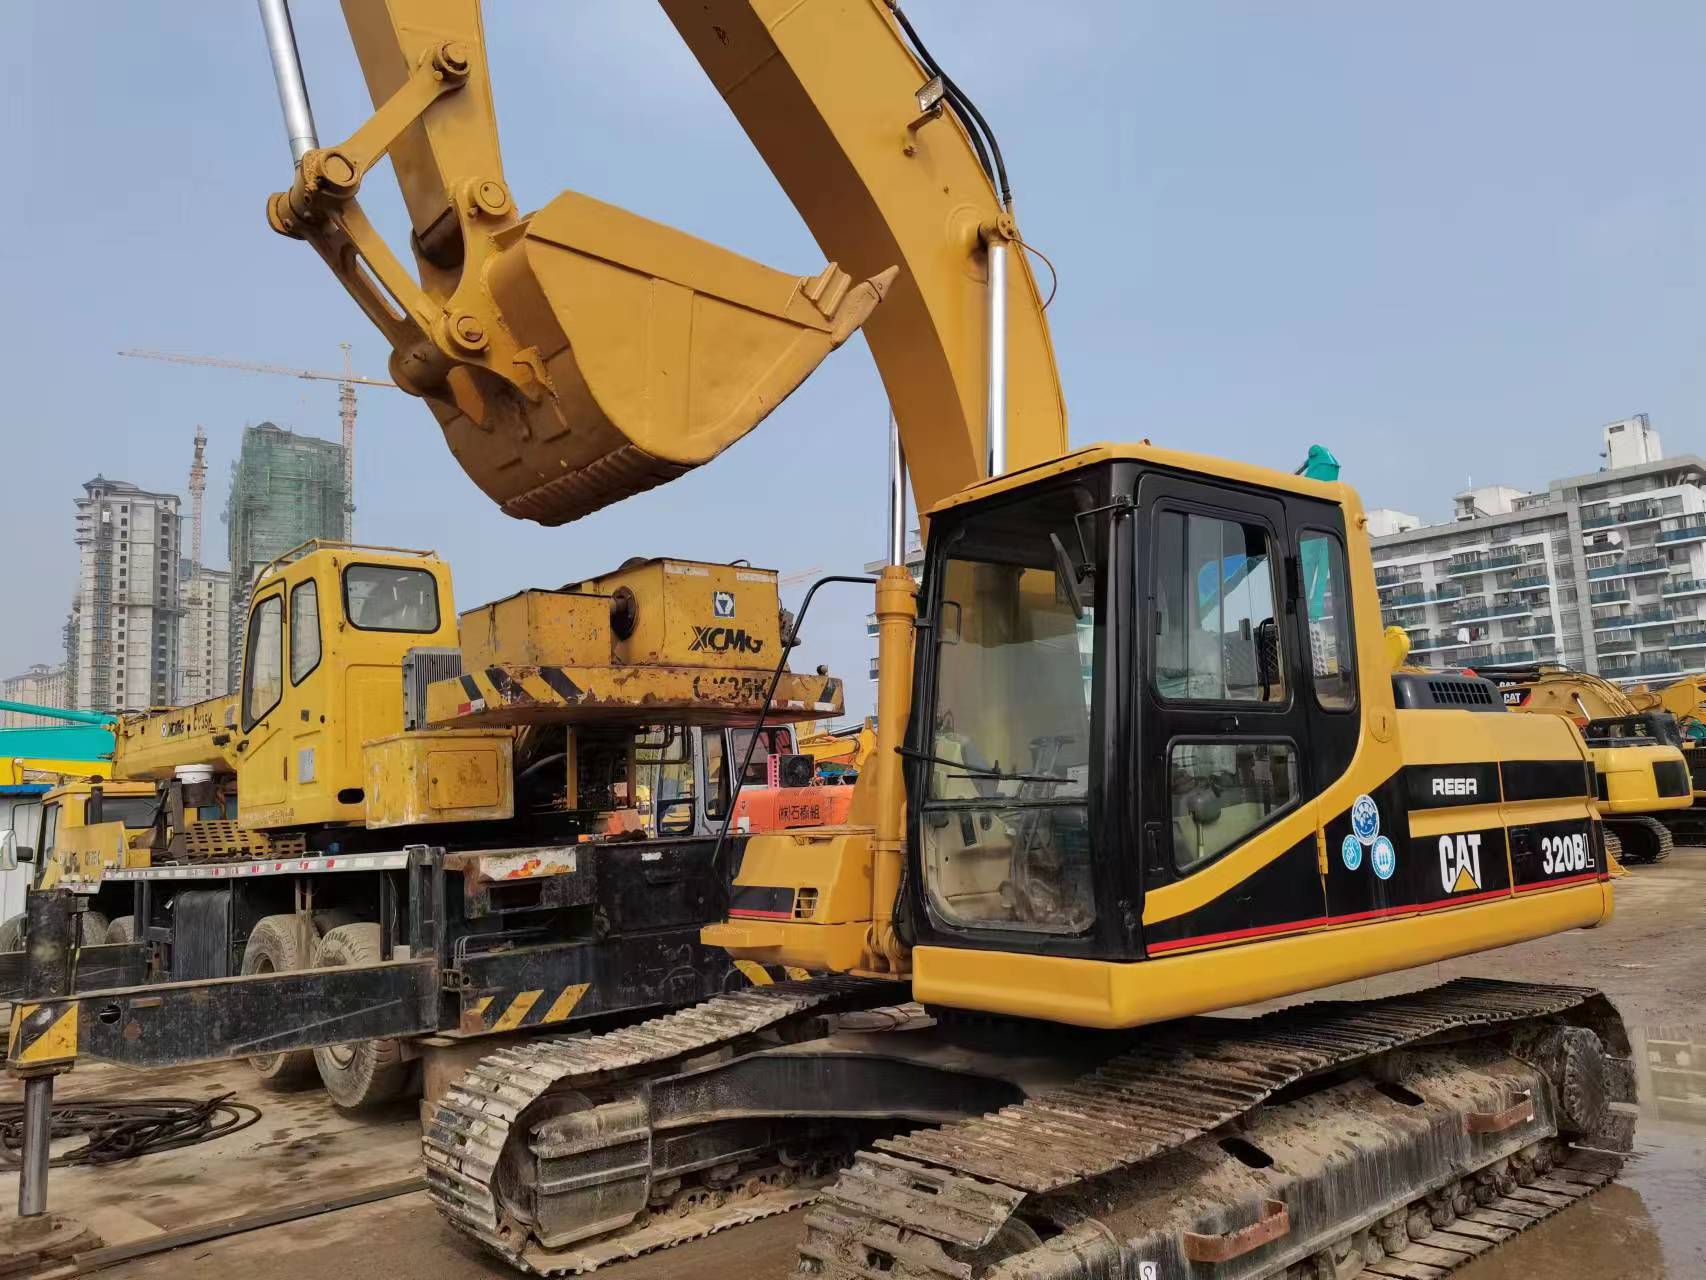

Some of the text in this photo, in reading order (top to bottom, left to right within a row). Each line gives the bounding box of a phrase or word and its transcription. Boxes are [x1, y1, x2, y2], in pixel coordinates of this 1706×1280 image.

[688, 627, 763, 654] XCMG
[1504, 692, 1520, 704] CAT
[1432, 778, 1477, 795] REGA
[1438, 833, 1482, 893] CAT
[1541, 833, 1595, 874] 320BL
